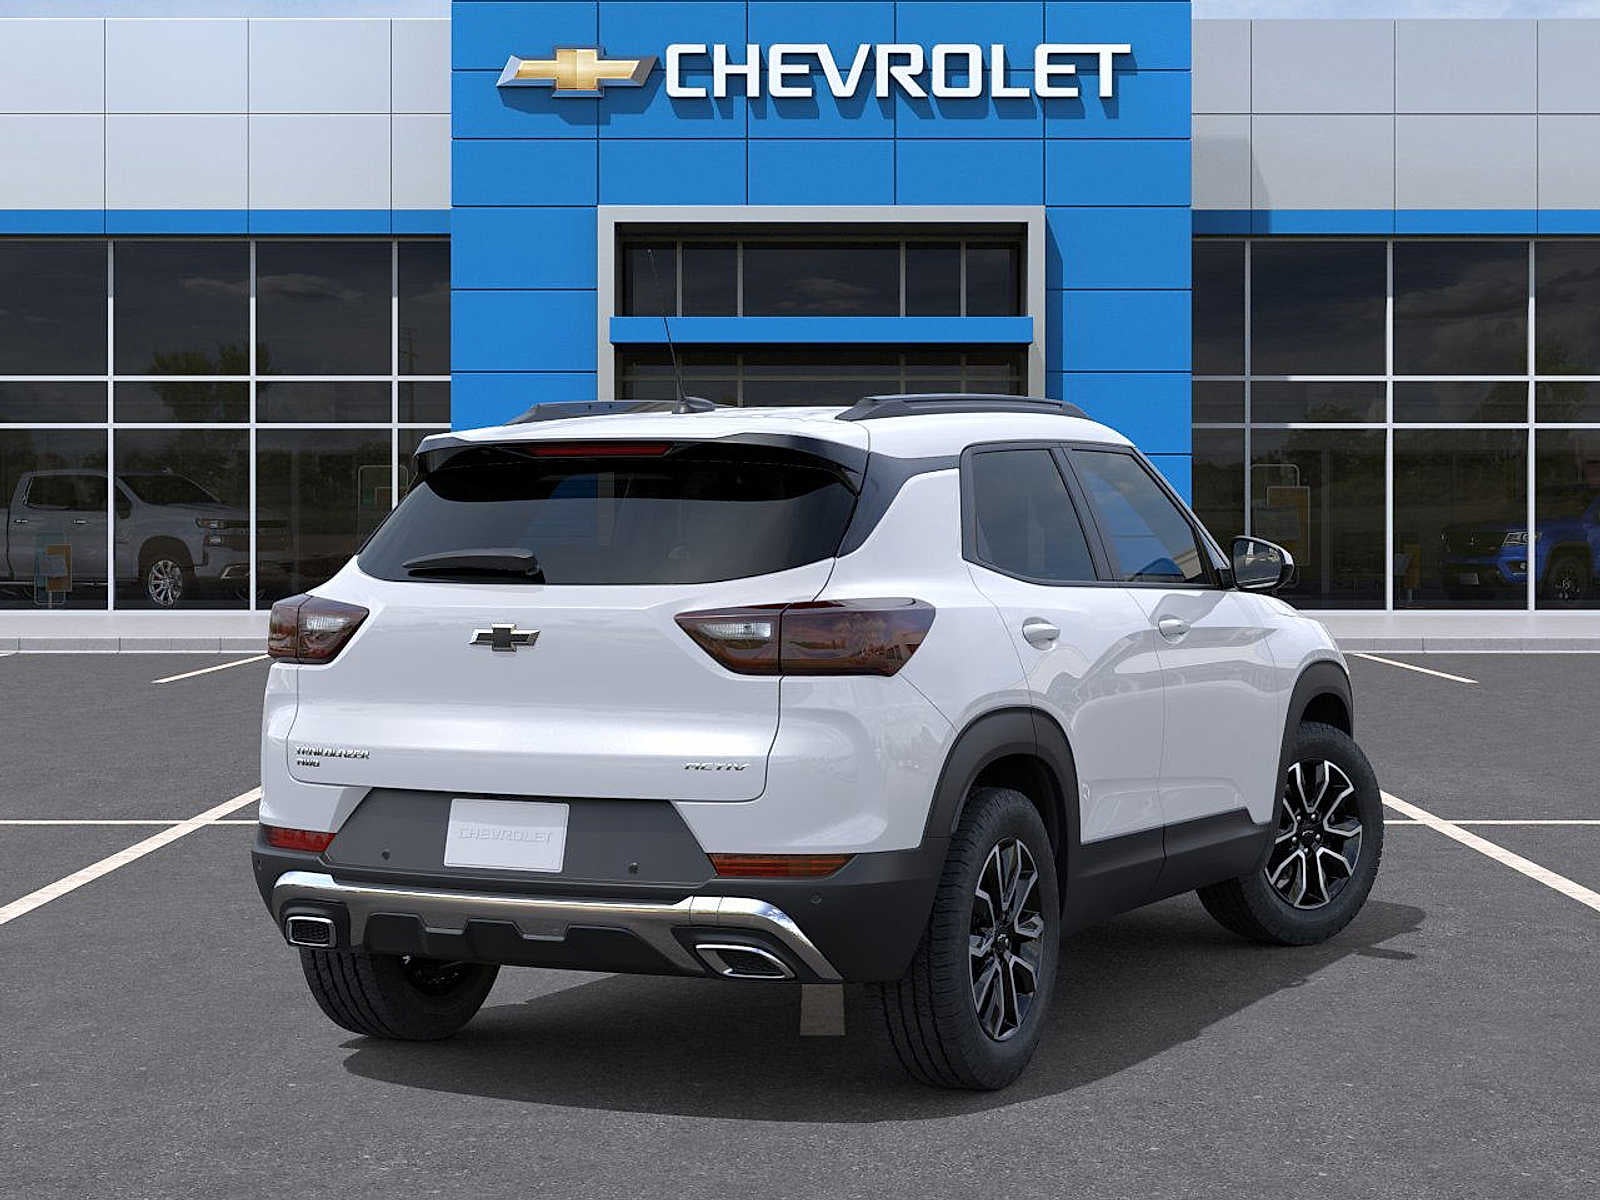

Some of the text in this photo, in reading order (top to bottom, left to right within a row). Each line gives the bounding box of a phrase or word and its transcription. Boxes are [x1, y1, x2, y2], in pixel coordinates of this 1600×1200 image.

[665, 43, 1132, 99] CHEVROLET
[684, 762, 751, 771] ACTIV
[457, 826, 553, 843] CHEVROLET
